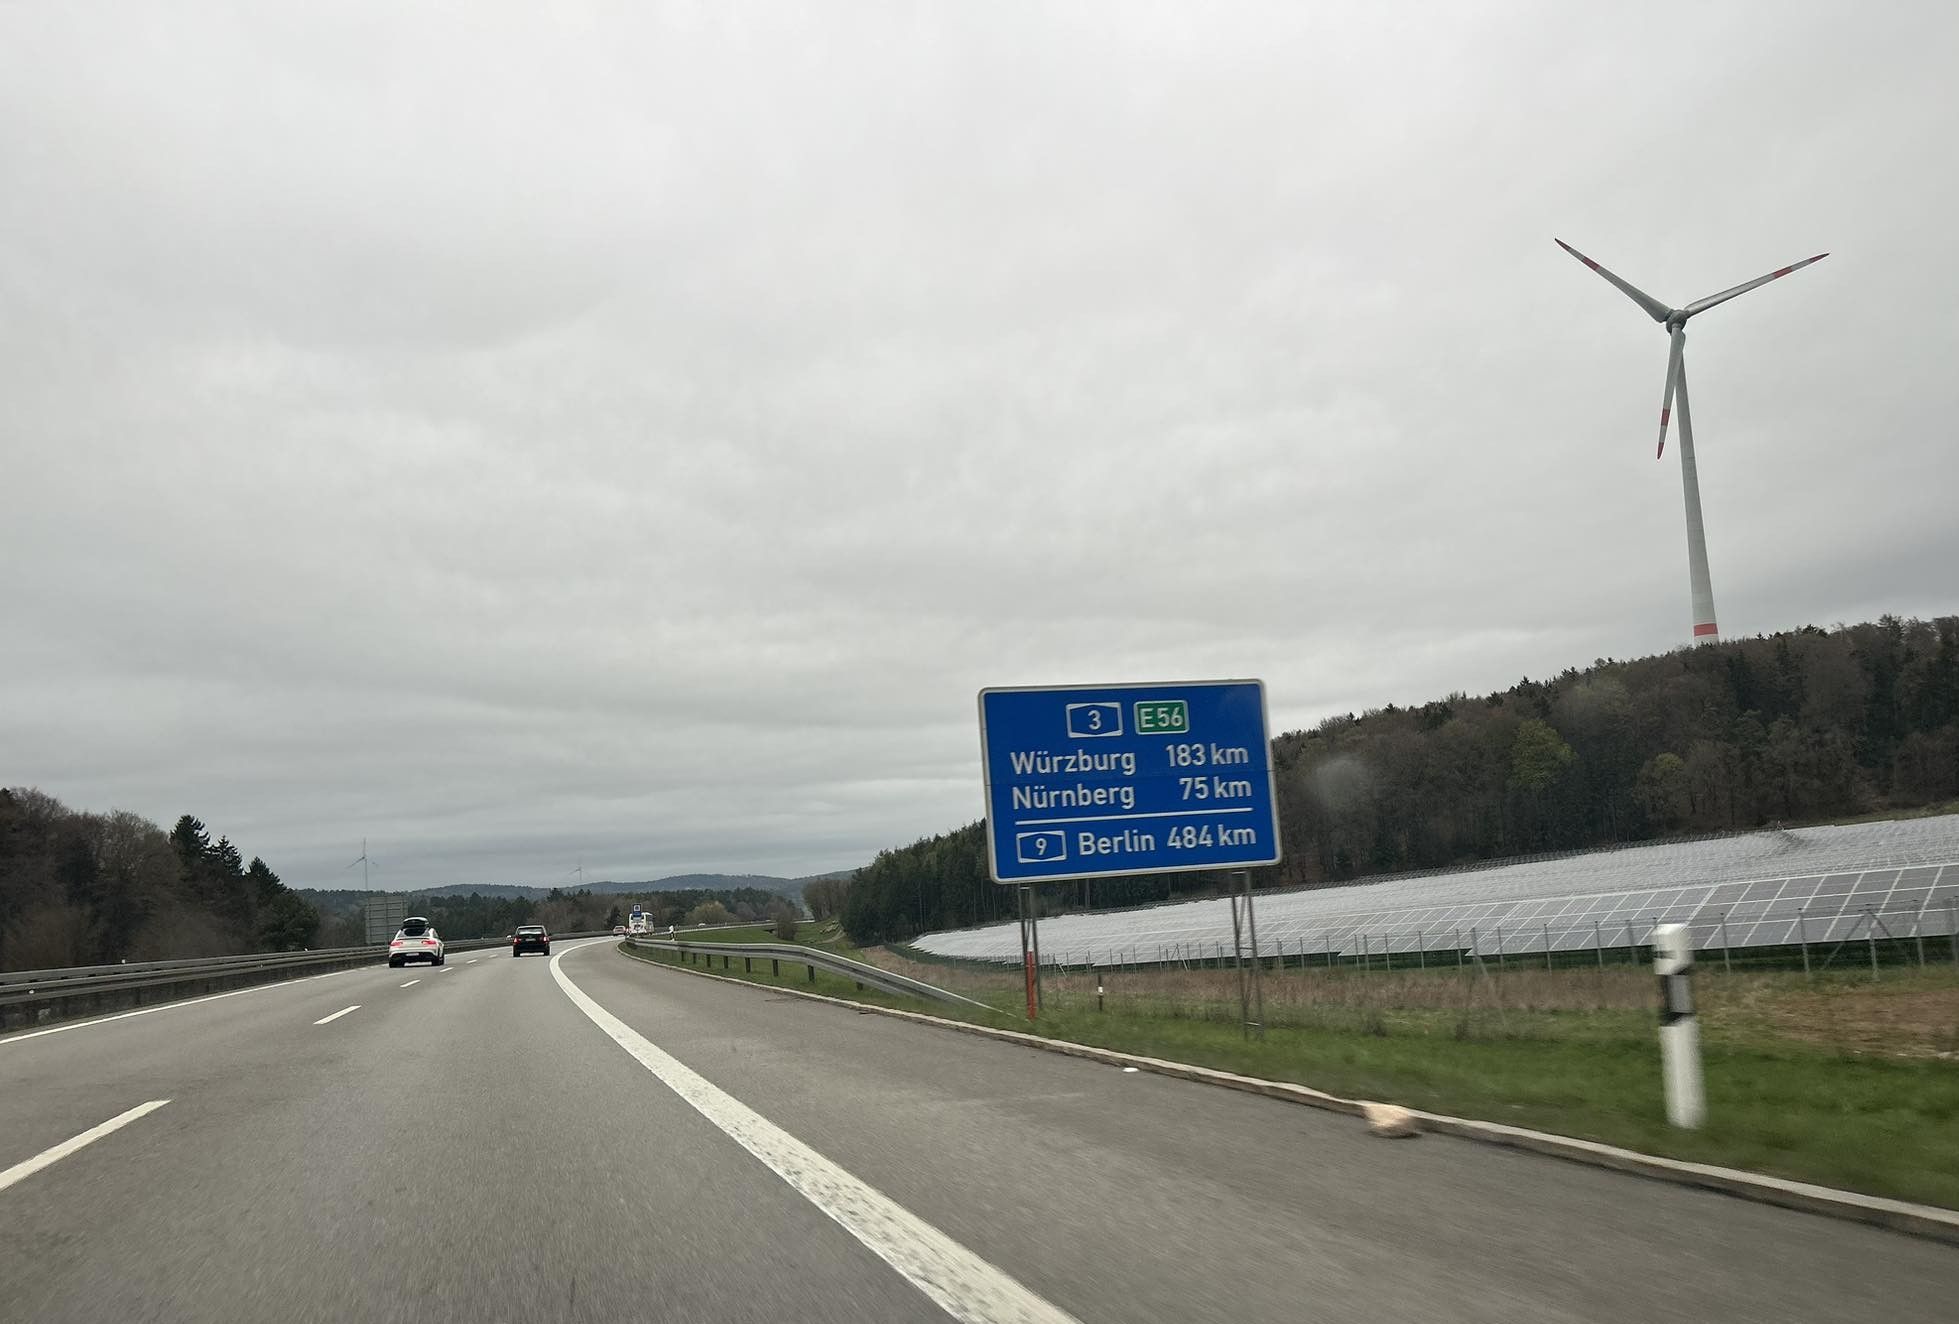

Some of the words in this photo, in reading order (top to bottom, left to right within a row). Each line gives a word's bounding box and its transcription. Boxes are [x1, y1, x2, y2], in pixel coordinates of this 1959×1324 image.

[1088, 710, 1102, 730] 3
[1010, 749, 1136, 775] Würzburg
[1166, 744, 1206, 767] 183
[1211, 742, 1248, 764] km
[1012, 783, 1134, 809] Nürnberg
[1179, 777, 1208, 800] 75
[1213, 776, 1252, 798] km
[1035, 838, 1047, 855] 9
[1079, 830, 1155, 855] Berlin
[1167, 825, 1212, 849] 484
[1219, 824, 1256, 846] km
